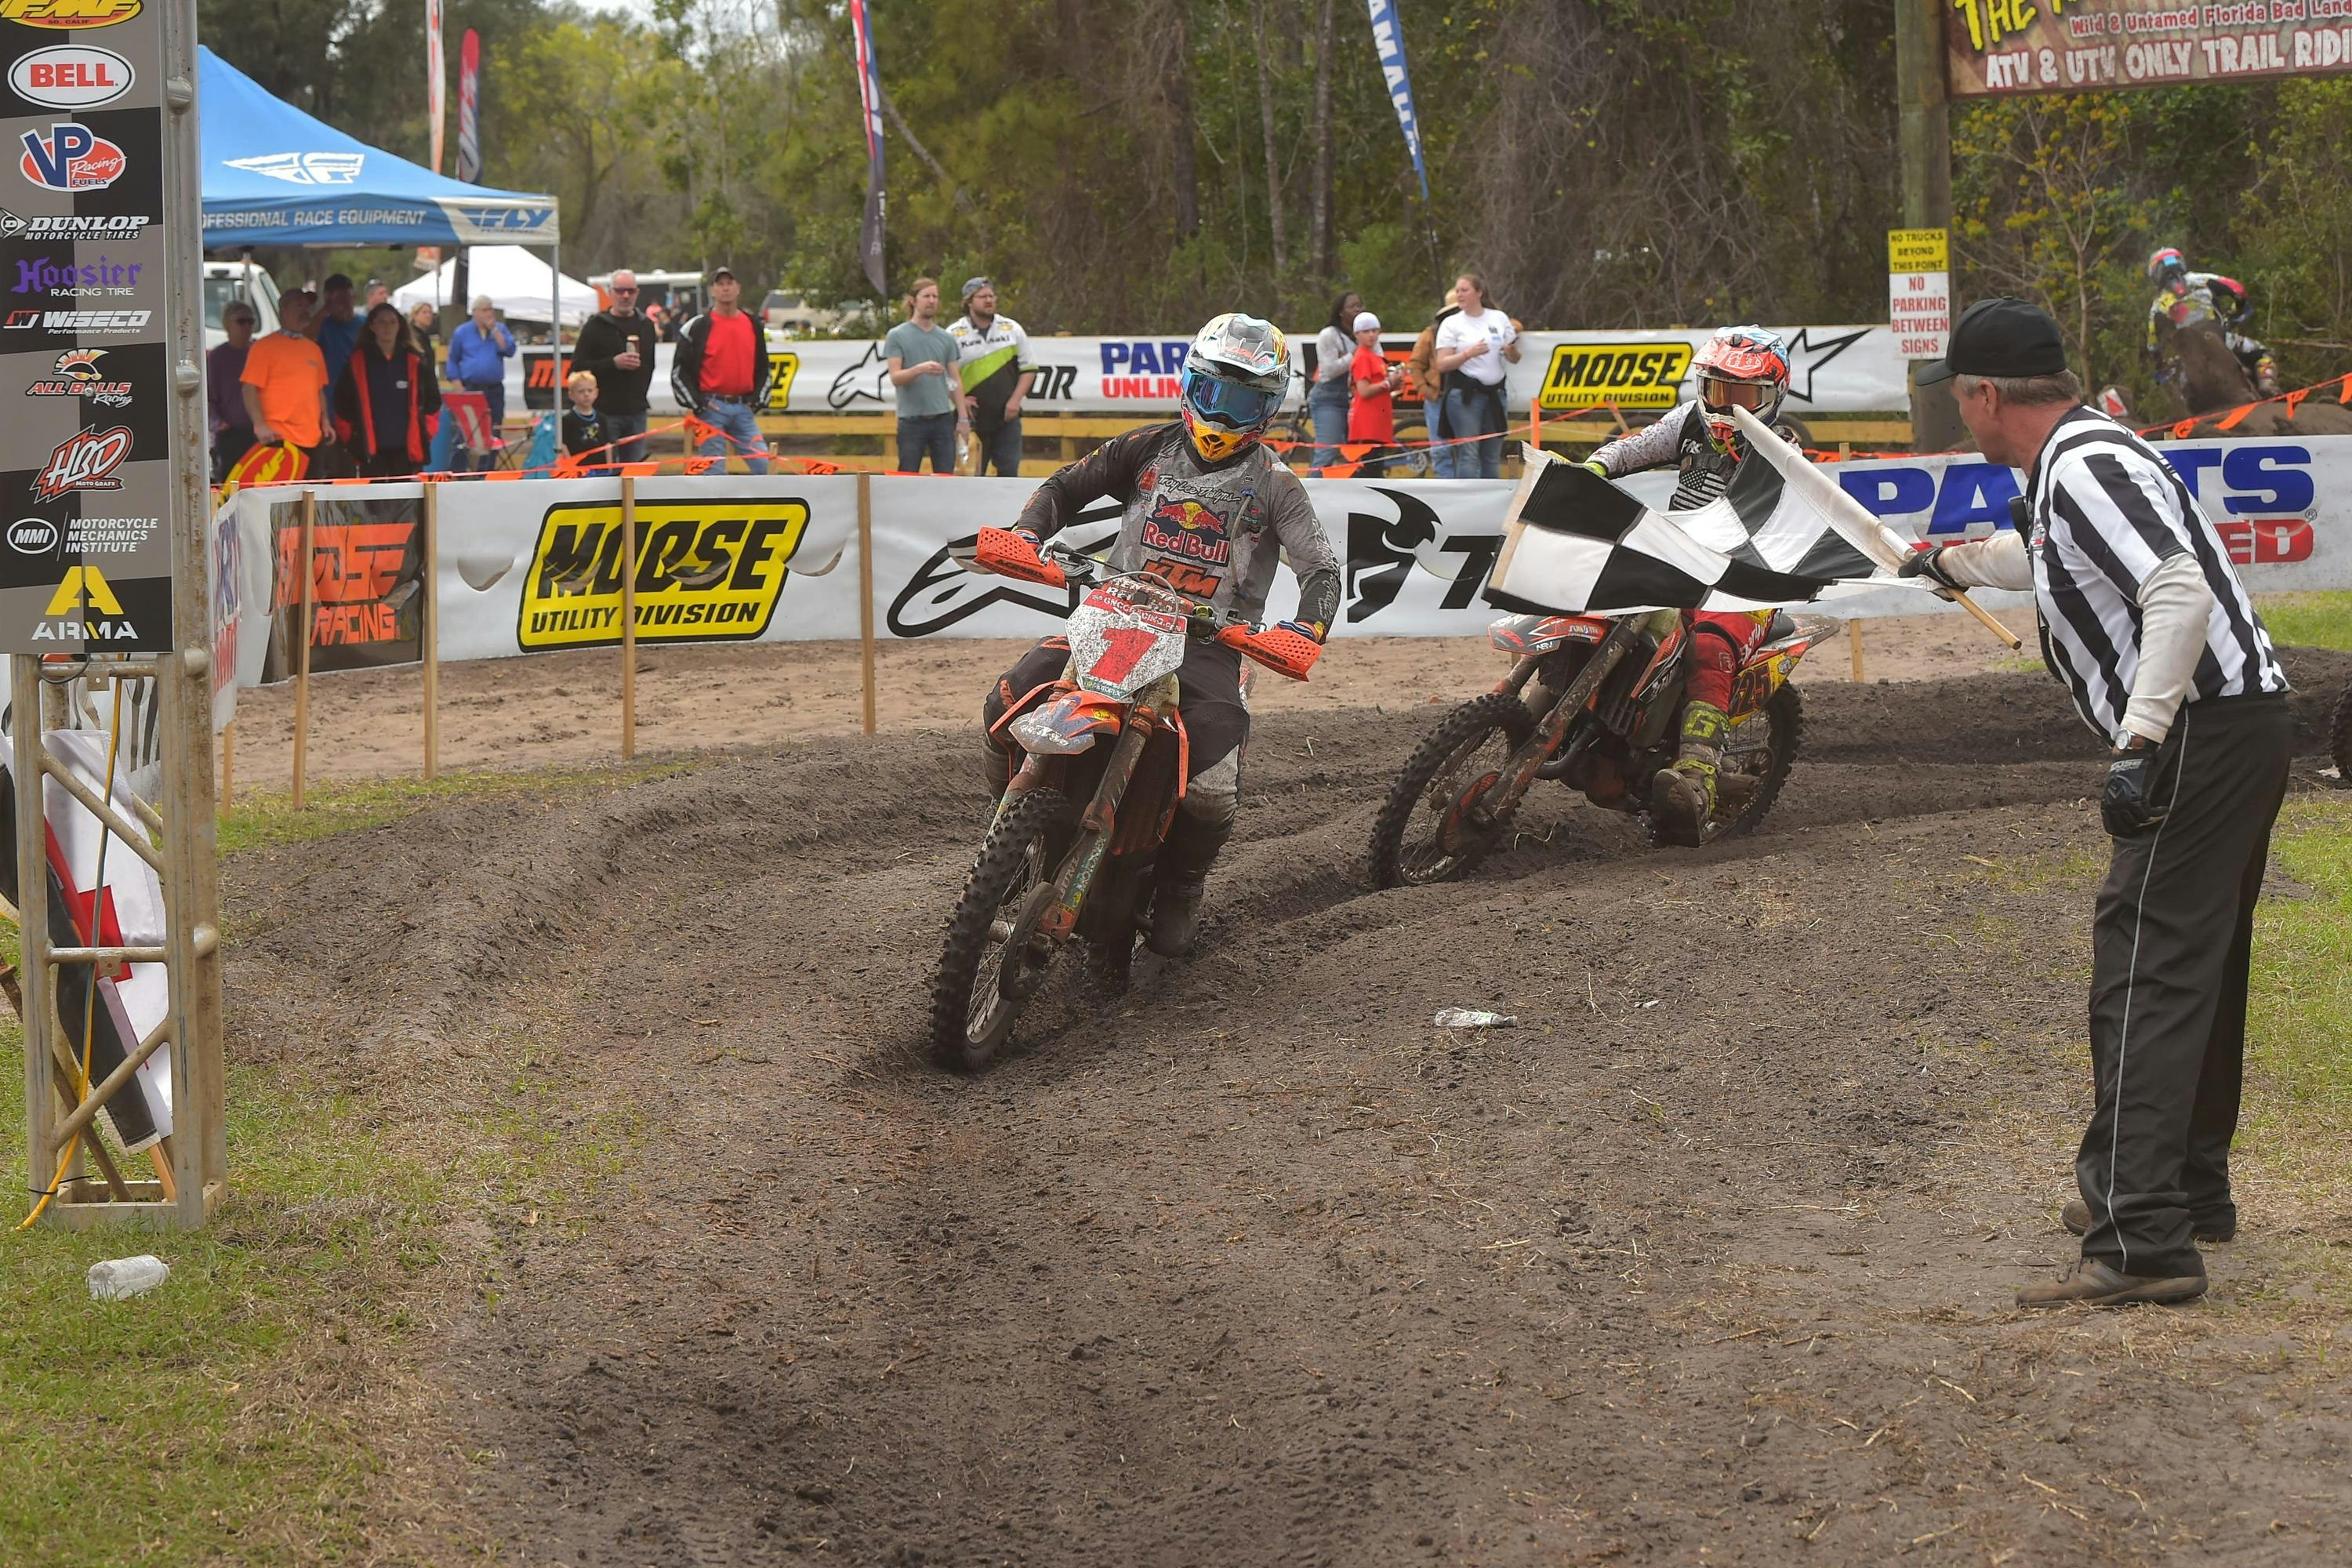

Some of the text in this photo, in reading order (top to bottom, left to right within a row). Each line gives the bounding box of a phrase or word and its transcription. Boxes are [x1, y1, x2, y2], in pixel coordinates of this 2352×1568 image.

[2071, 14, 2103, 36] Wild
[2108, 14, 2121, 32] &
[2126, 8, 2198, 33] Untamed
[2204, 5, 2265, 25] Florida
[2273, 0, 2304, 20] Bad
[1986, 51, 2029, 89] ATV
[2039, 49, 2059, 83] &
[2065, 45, 2115, 83] UTV
[2125, 41, 2192, 79] ONLY
[2201, 33, 2285, 74] TRAIL
[30, 63, 114, 88] BELL
[24, 126, 93, 188] VP
[71, 157, 126, 179] Racing
[28, 216, 150, 230] DUNLOP
[294, 210, 334, 226] RACE
[339, 209, 426, 226] EQUIPMENT
[25, 230, 140, 241] MOTORCYCLE TIRES
[1906, 233, 1944, 242] TRUCKS
[1897, 247, 1934, 256] BEYOND
[1893, 260, 1944, 270] THIS POINT
[11, 255, 143, 293] Hoosier
[50, 287, 135, 296] RACING TIRE
[1909, 277, 1926, 291] NO
[1893, 296, 1946, 313] PARKING
[1892, 318, 1948, 333] BETWEEN
[1902, 338, 1938, 354] SIGNS
[1552, 352, 1682, 387] MOOSE
[27, 383, 65, 394] ALL
[93, 393, 133, 408] Racing
[1546, 392, 1670, 404] UTILITY DIVISION
[1158, 474, 1178, 492] Troy
[1178, 481, 1198, 495] Lee
[1198, 487, 1242, 504] Designs
[69, 518, 158, 529] MOTORCYCLE
[14, 528, 51, 544] MMI
[67, 530, 148, 541] MECHANICS
[1143, 521, 1230, 564] Red Bull
[65, 542, 137, 553] INSTITUTE
[537, 519, 789, 601] MOOSE
[1138, 557, 1221, 600] KTM
[530, 606, 619, 633] UTILITY
[31, 621, 139, 641] ARMA
[1088, 627, 1160, 685] 1
